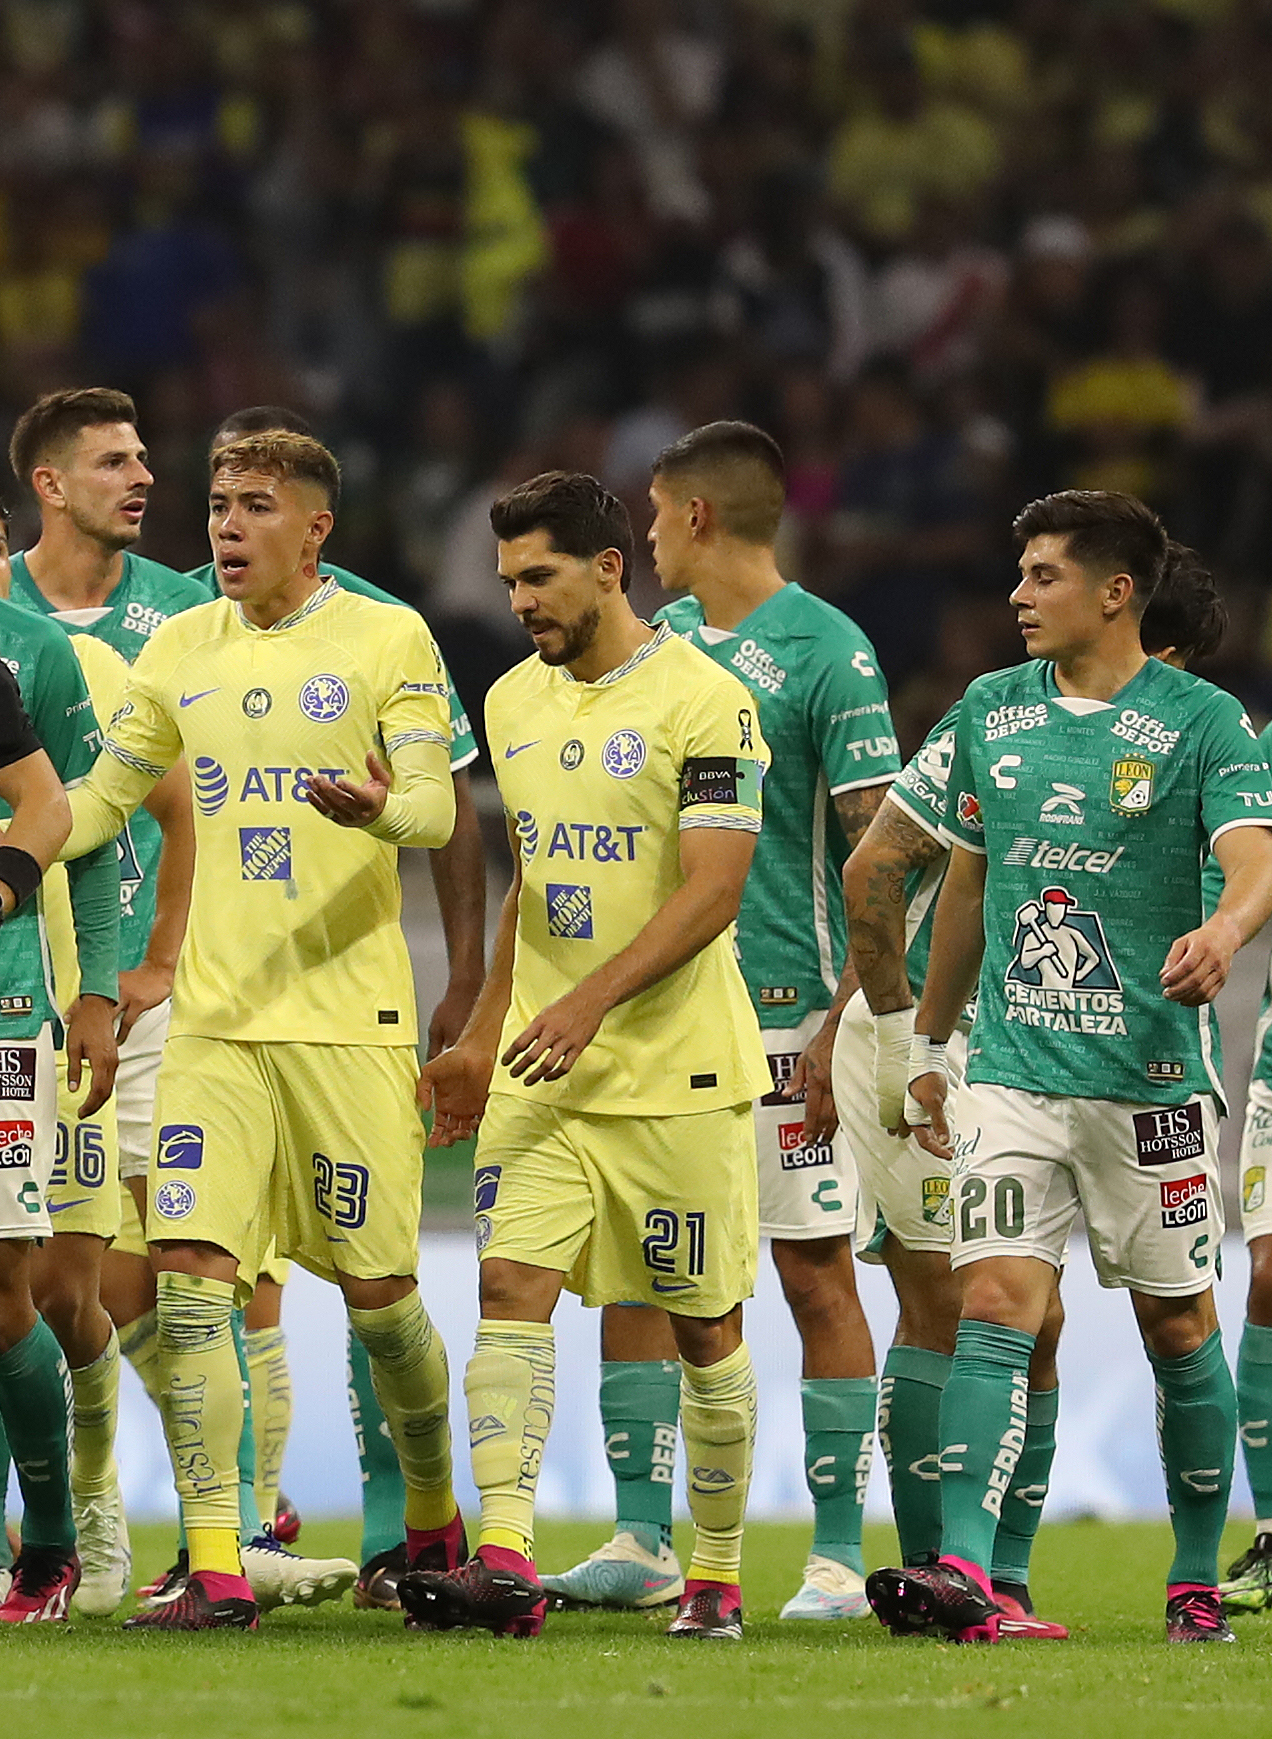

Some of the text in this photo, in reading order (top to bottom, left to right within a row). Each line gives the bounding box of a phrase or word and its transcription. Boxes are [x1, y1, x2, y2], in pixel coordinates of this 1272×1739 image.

[127, 603, 167, 626] Offi
[730, 651, 782, 694] DEPOT
[740, 639, 786, 683] Office
[985, 703, 1047, 728] Office
[985, 714, 1048, 741] DEPOT
[1120, 709, 1181, 743] Office
[1110, 721, 1175, 755] DEPOT
[1236, 790, 1272, 807] TU
[242, 827, 290, 880] HOME
[547, 823, 643, 862] AT&T
[1030, 840, 1125, 873] telcel
[549, 886, 591, 936] HOME
[1004, 984, 1124, 1014] CEMENTOS
[1005, 1006, 1128, 1036] FORTALEZA
[773, 1055, 796, 1080] H
[2, 1087, 31, 1097] HOTEL
[1151, 1109, 1190, 1138] HS
[1140, 1129, 1201, 1153] HOTSSON
[1172, 1143, 1202, 1159] HOTEL
[313, 1153, 369, 1229] 23
[926, 1180, 949, 1194] LEO
[1164, 1181, 1206, 1206] leche
[961, 1177, 1025, 1242] 20
[643, 1209, 706, 1277] 21
